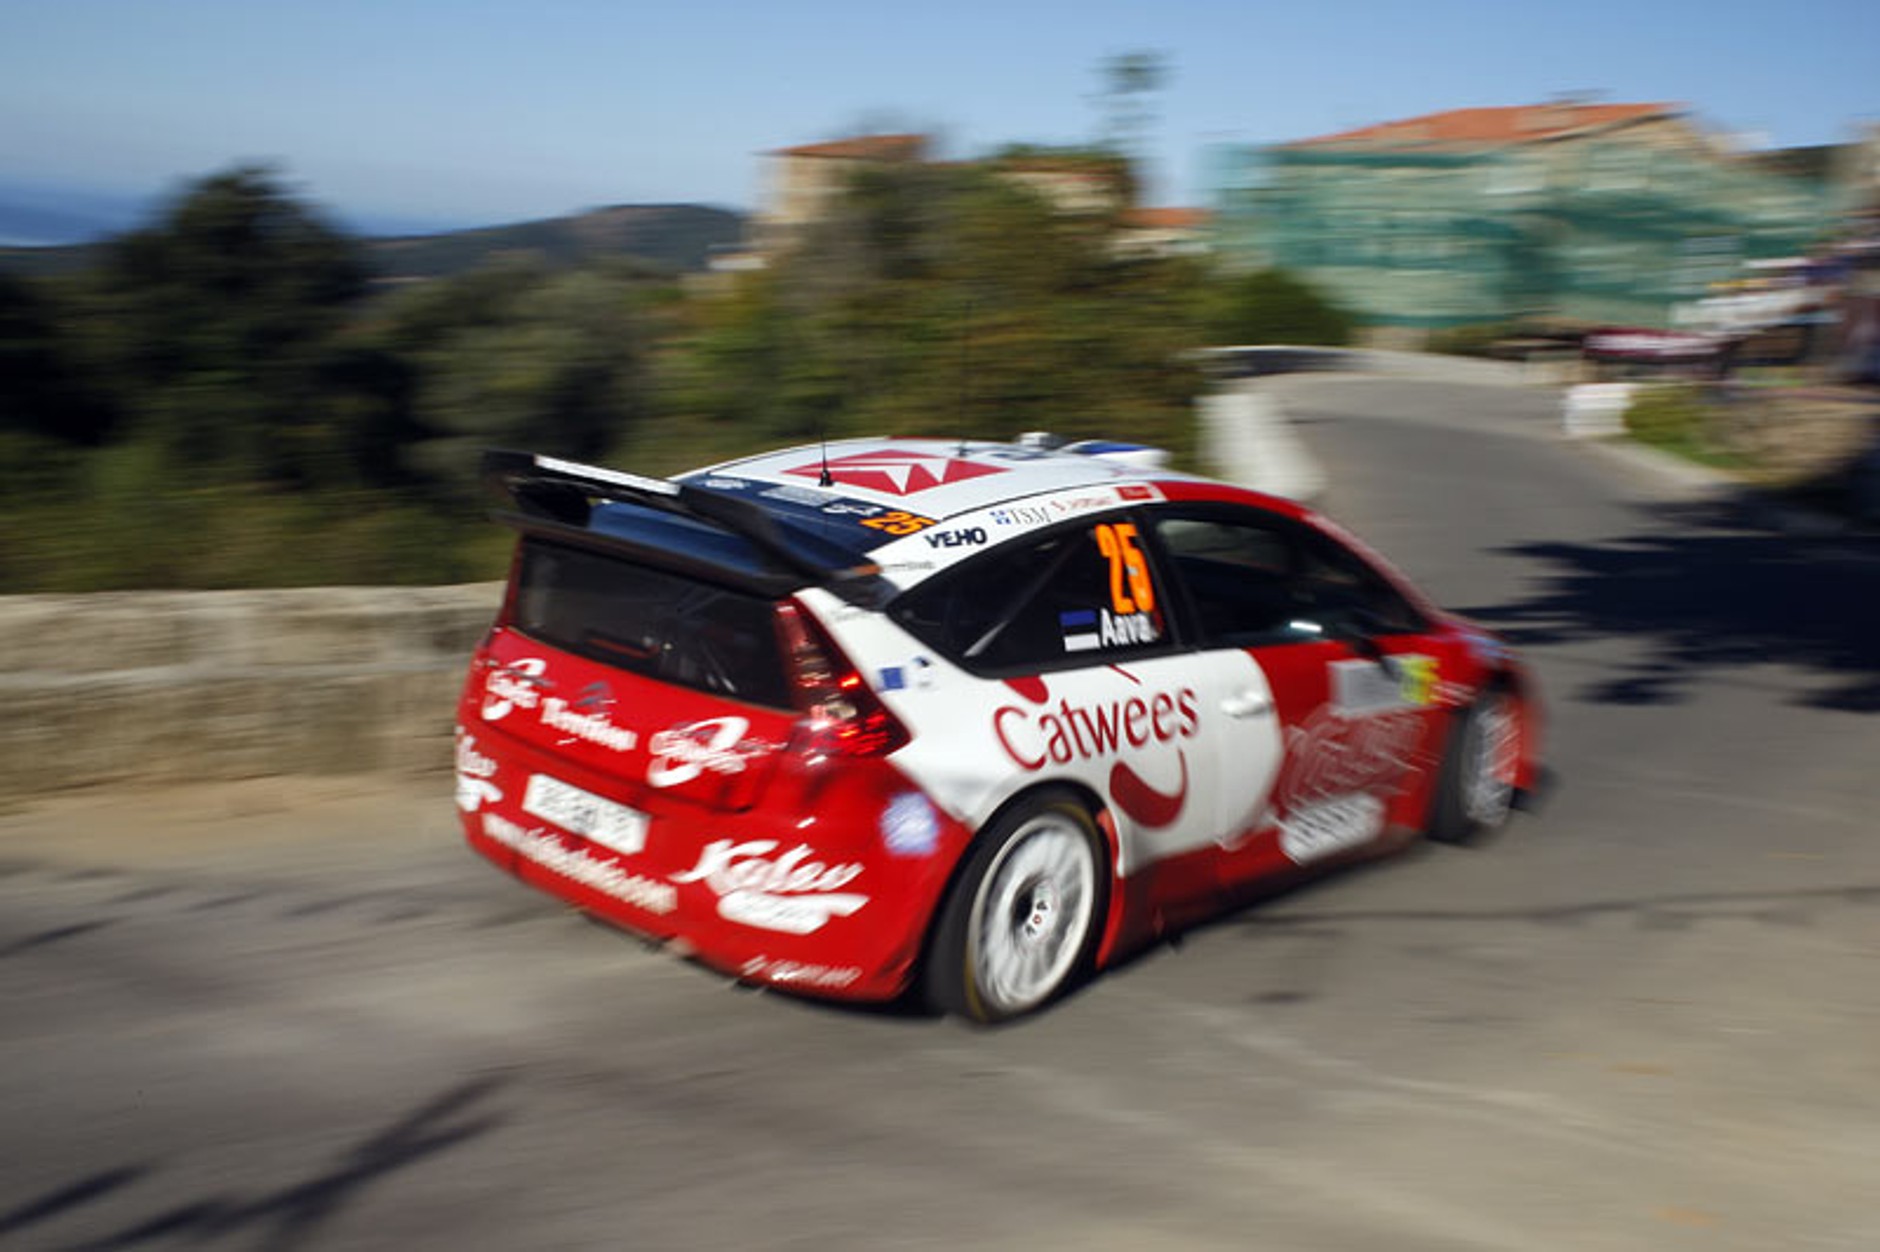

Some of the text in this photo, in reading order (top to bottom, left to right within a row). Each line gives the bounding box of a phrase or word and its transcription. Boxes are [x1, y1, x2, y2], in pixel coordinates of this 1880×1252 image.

[858, 511, 939, 535] 25
[924, 526, 988, 548] VEHO
[1095, 523, 1155, 614] 25
[993, 686, 1199, 771] Catwees
